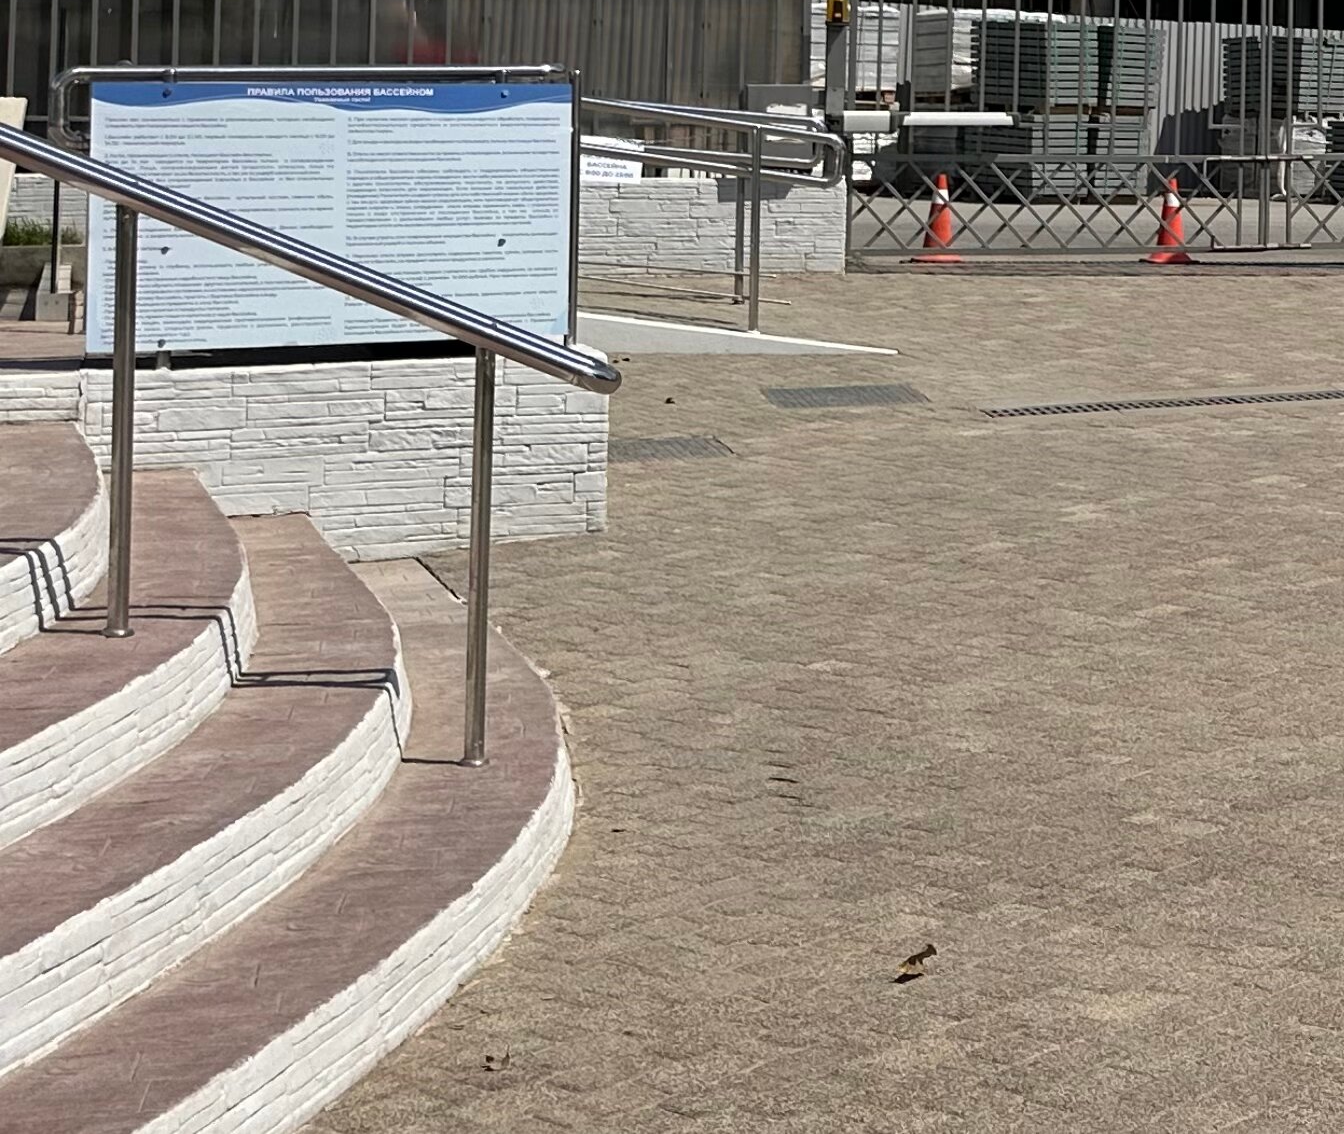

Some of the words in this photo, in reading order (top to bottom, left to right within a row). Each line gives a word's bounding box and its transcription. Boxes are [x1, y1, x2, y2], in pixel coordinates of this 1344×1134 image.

[247, 88, 295, 96] ПРАВИЛА
[297, 88, 371, 96] ПОЛЬЗОВАНИЯ
[373, 87, 434, 96] БАССЕЙНОМ
